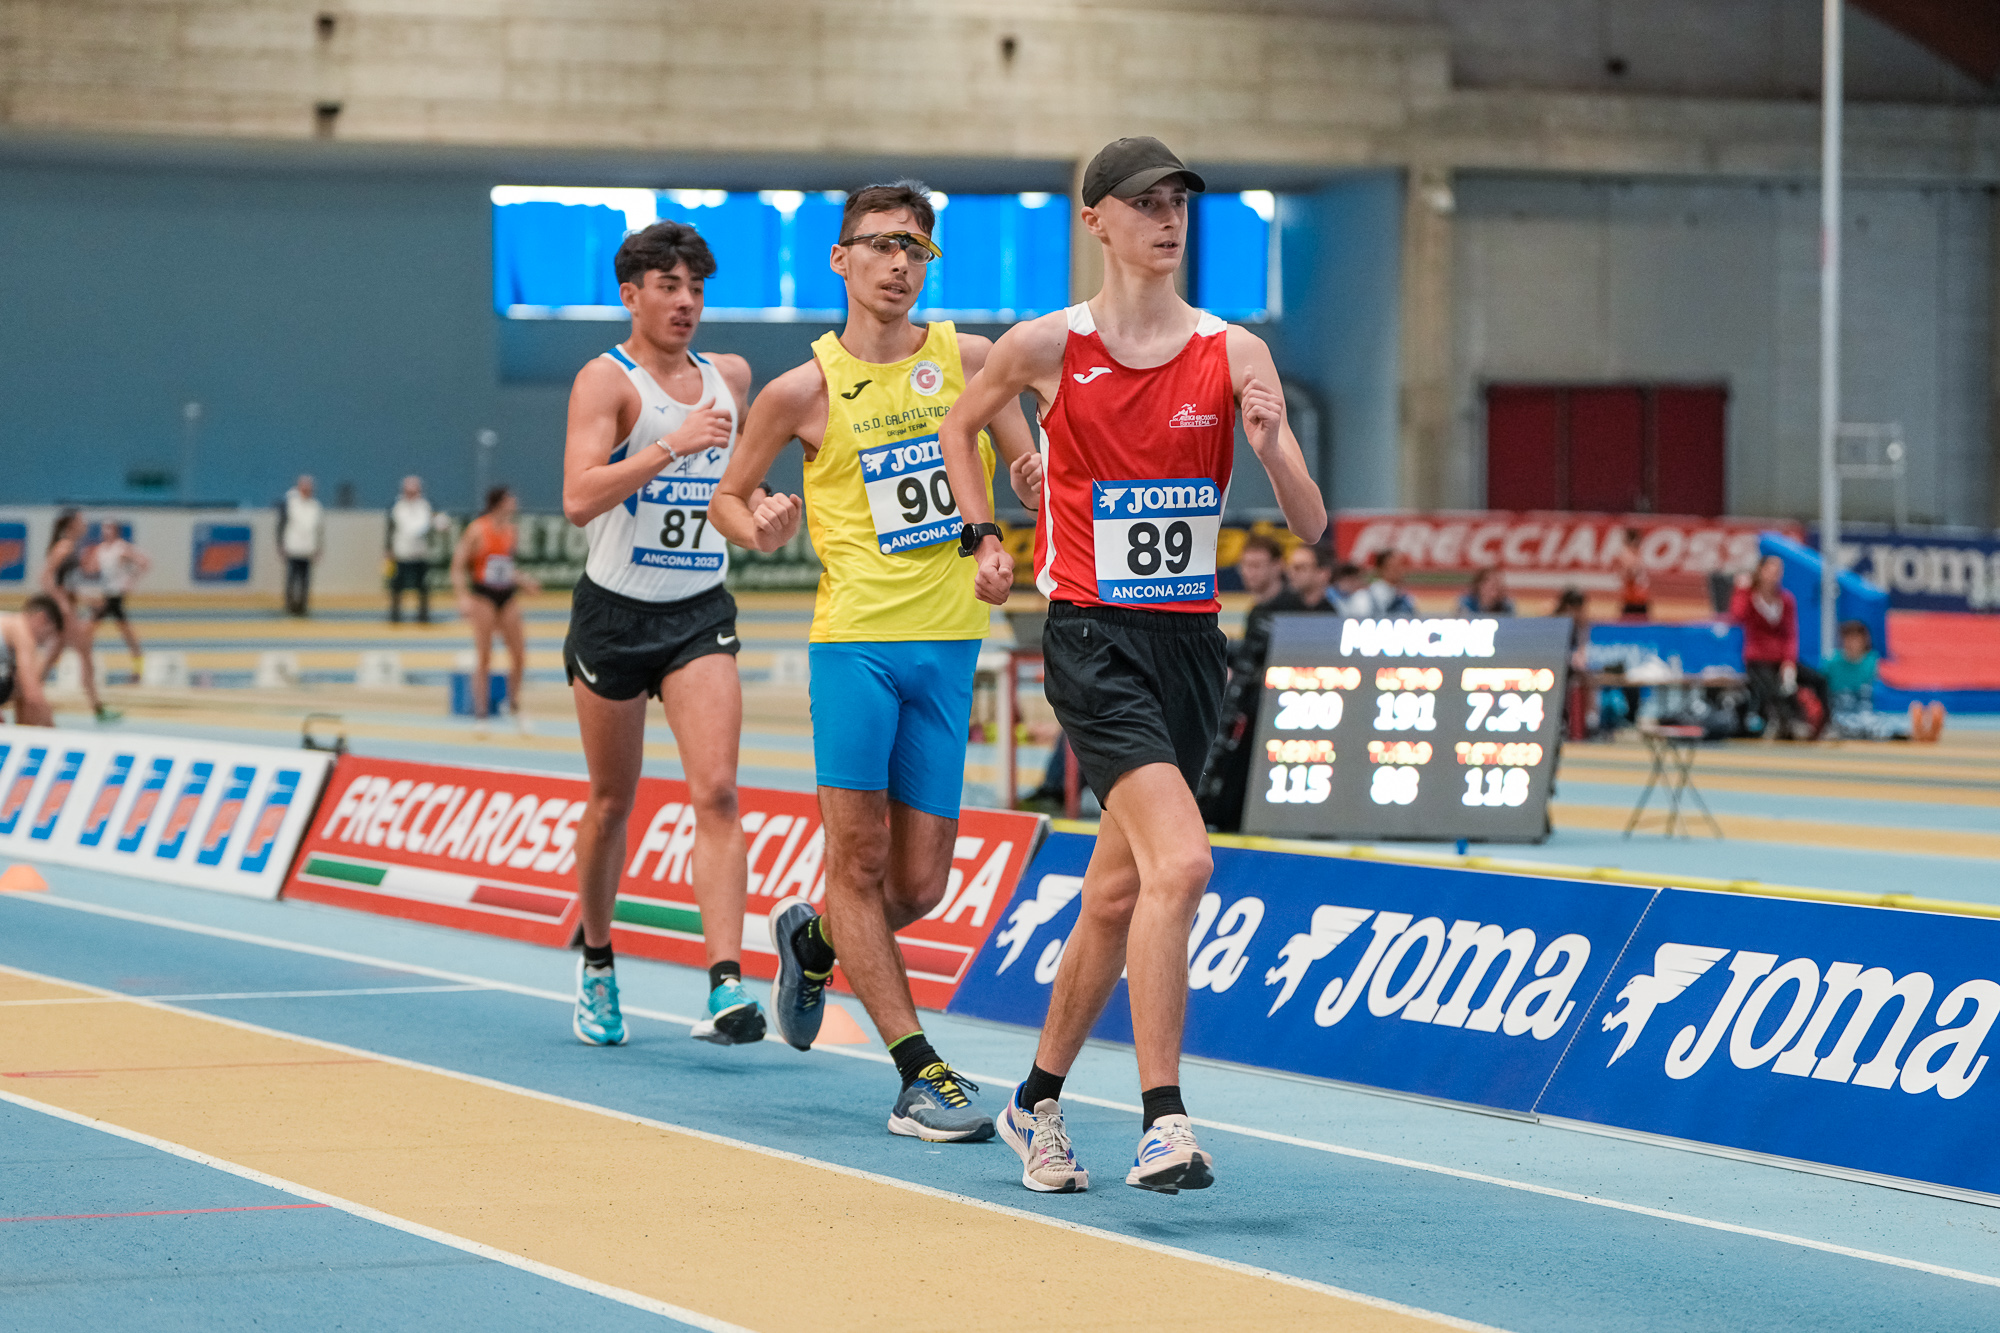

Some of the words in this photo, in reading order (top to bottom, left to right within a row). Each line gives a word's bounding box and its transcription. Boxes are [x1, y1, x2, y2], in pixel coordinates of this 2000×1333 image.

[852, 417, 884, 434] A.S.D.
[885, 405, 951, 426] GALATLETICA
[890, 440, 943, 473] Jom
[896, 469, 957, 524] 90
[1127, 485, 1218, 514] Joma
[659, 508, 708, 550] 87
[890, 525, 950, 549] ANCONA
[949, 521, 964, 536] 20
[1126, 520, 1193, 577] 89
[641, 552, 693, 567] ANCONA
[693, 556, 720, 568] 2025
[1111, 584, 1175, 599] ANCONA
[1176, 582, 1206, 596] 2025
[1274, 690, 1344, 731] 200
[1373, 691, 1437, 732] 191
[1465, 692, 1545, 732] 7.24
[1265, 764, 1334, 804] 115
[1313, 910, 1592, 1041] Joma
[1664, 949, 2000, 1100] Joma
